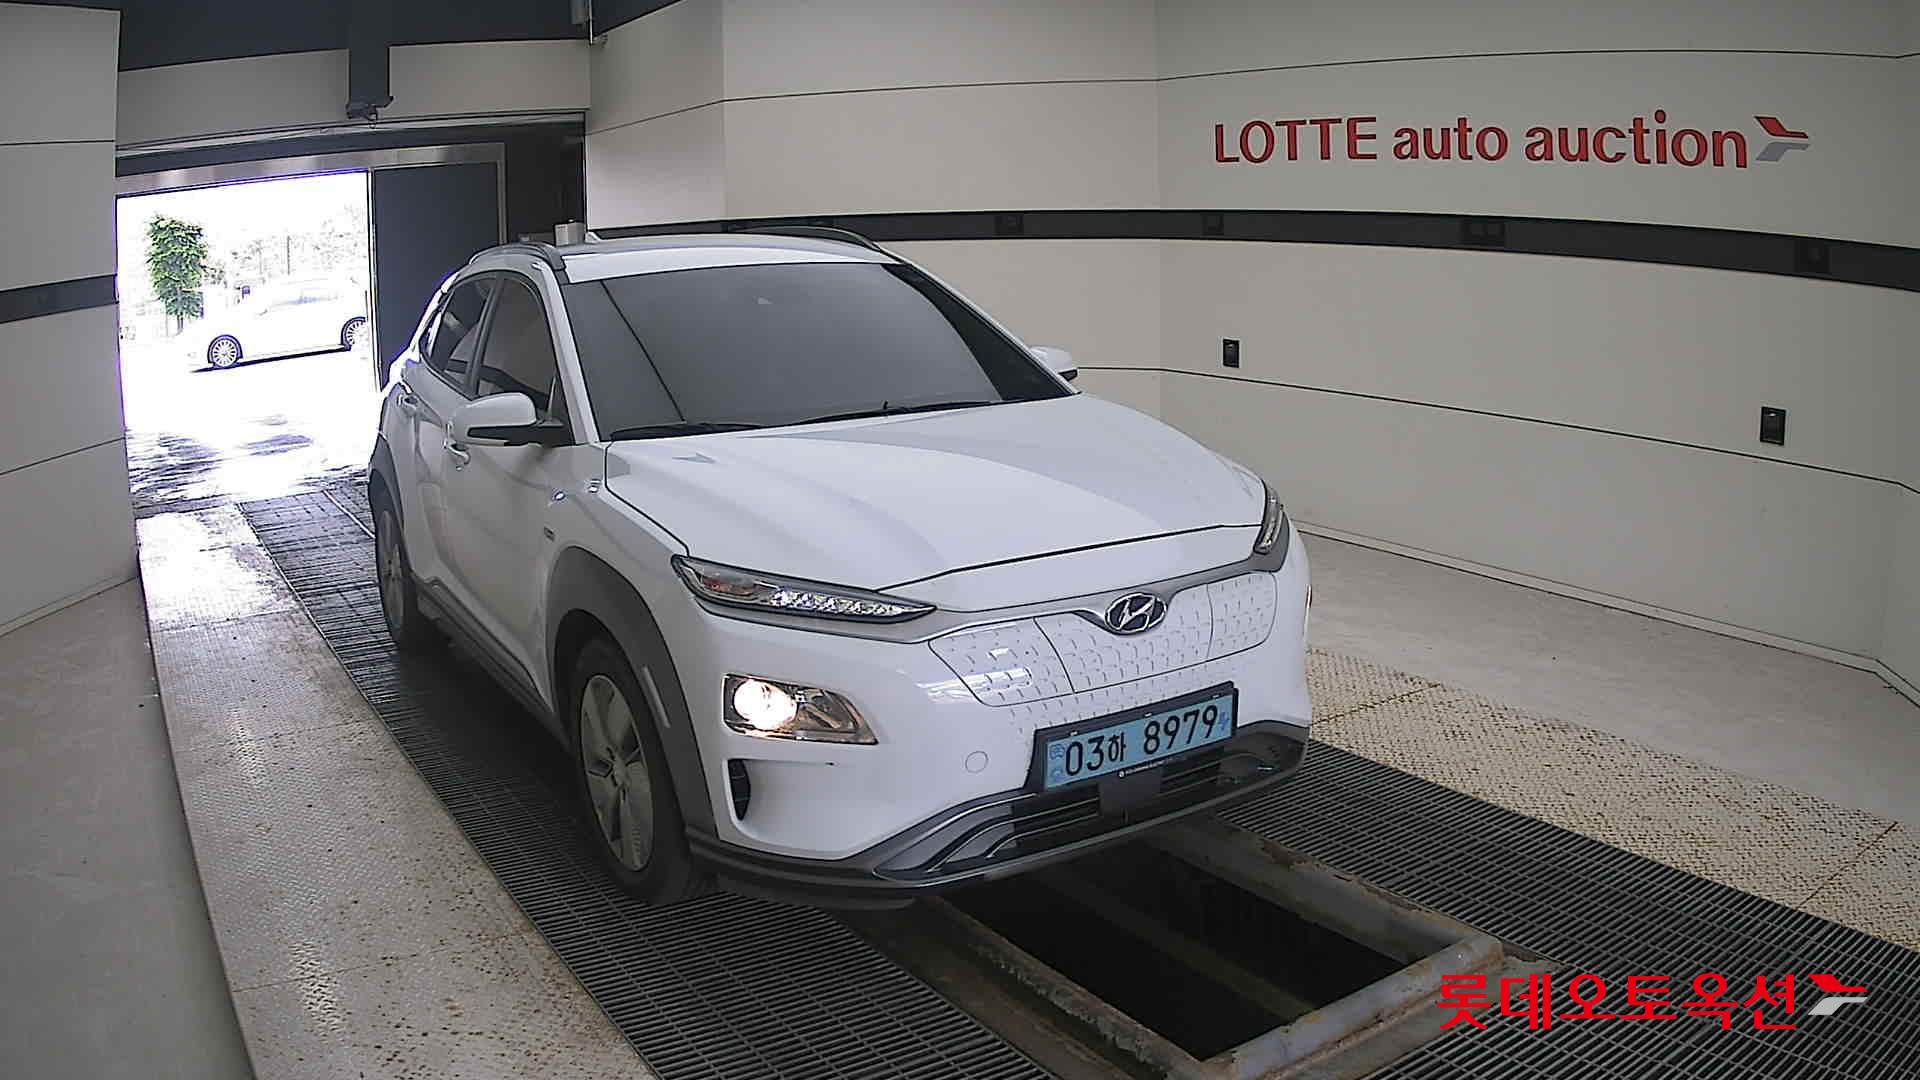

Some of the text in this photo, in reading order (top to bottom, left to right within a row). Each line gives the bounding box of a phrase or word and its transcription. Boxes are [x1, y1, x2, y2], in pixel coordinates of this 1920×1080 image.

[1214, 110, 1749, 169] LOTTE auto auction
[1065, 704, 1219, 777] 03하 8979
